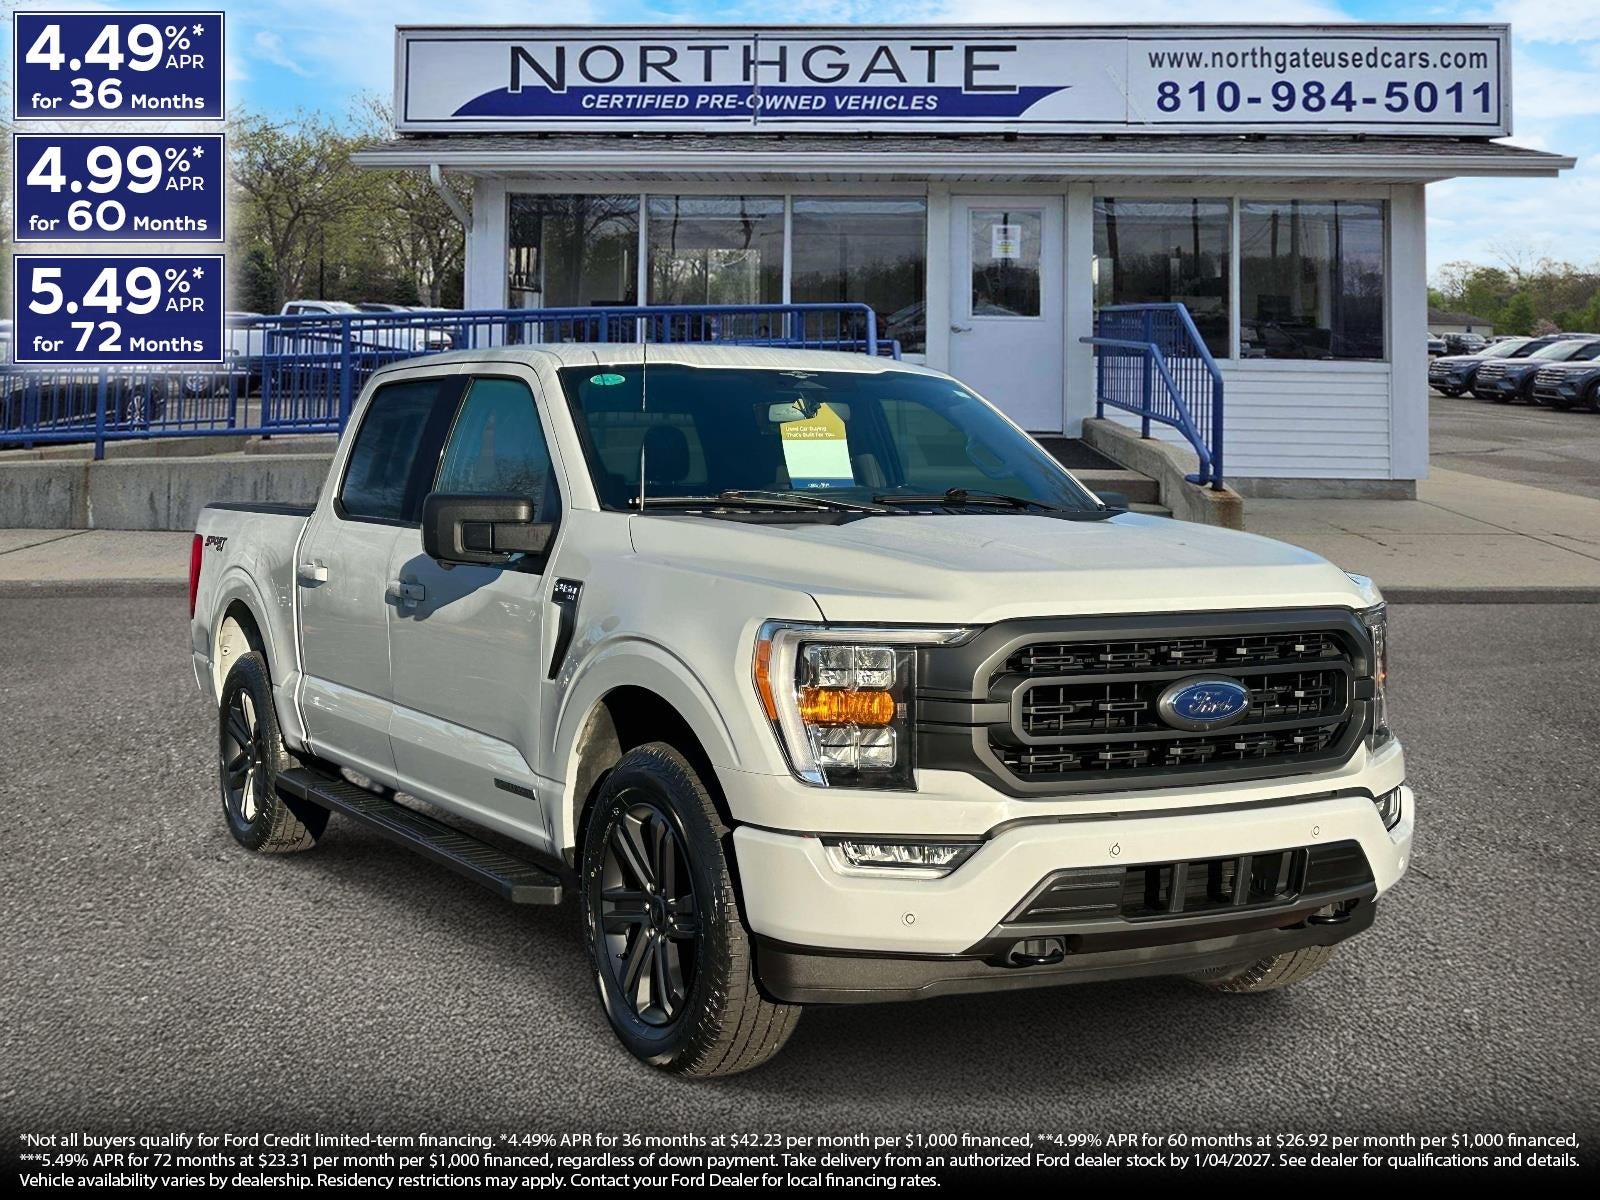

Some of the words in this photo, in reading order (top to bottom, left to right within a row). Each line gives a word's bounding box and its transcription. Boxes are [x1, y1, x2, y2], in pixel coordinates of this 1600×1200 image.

[509, 44, 1018, 92] NORTHGATE
[1148, 46, 1488, 73] www.northgateusedcars.com
[581, 94, 689, 109] CERTIFIED
[695, 94, 827, 110] PRE-OWNED
[834, 95, 938, 110] VEHICLES
[1156, 80, 1490, 113] 810-984-5011
